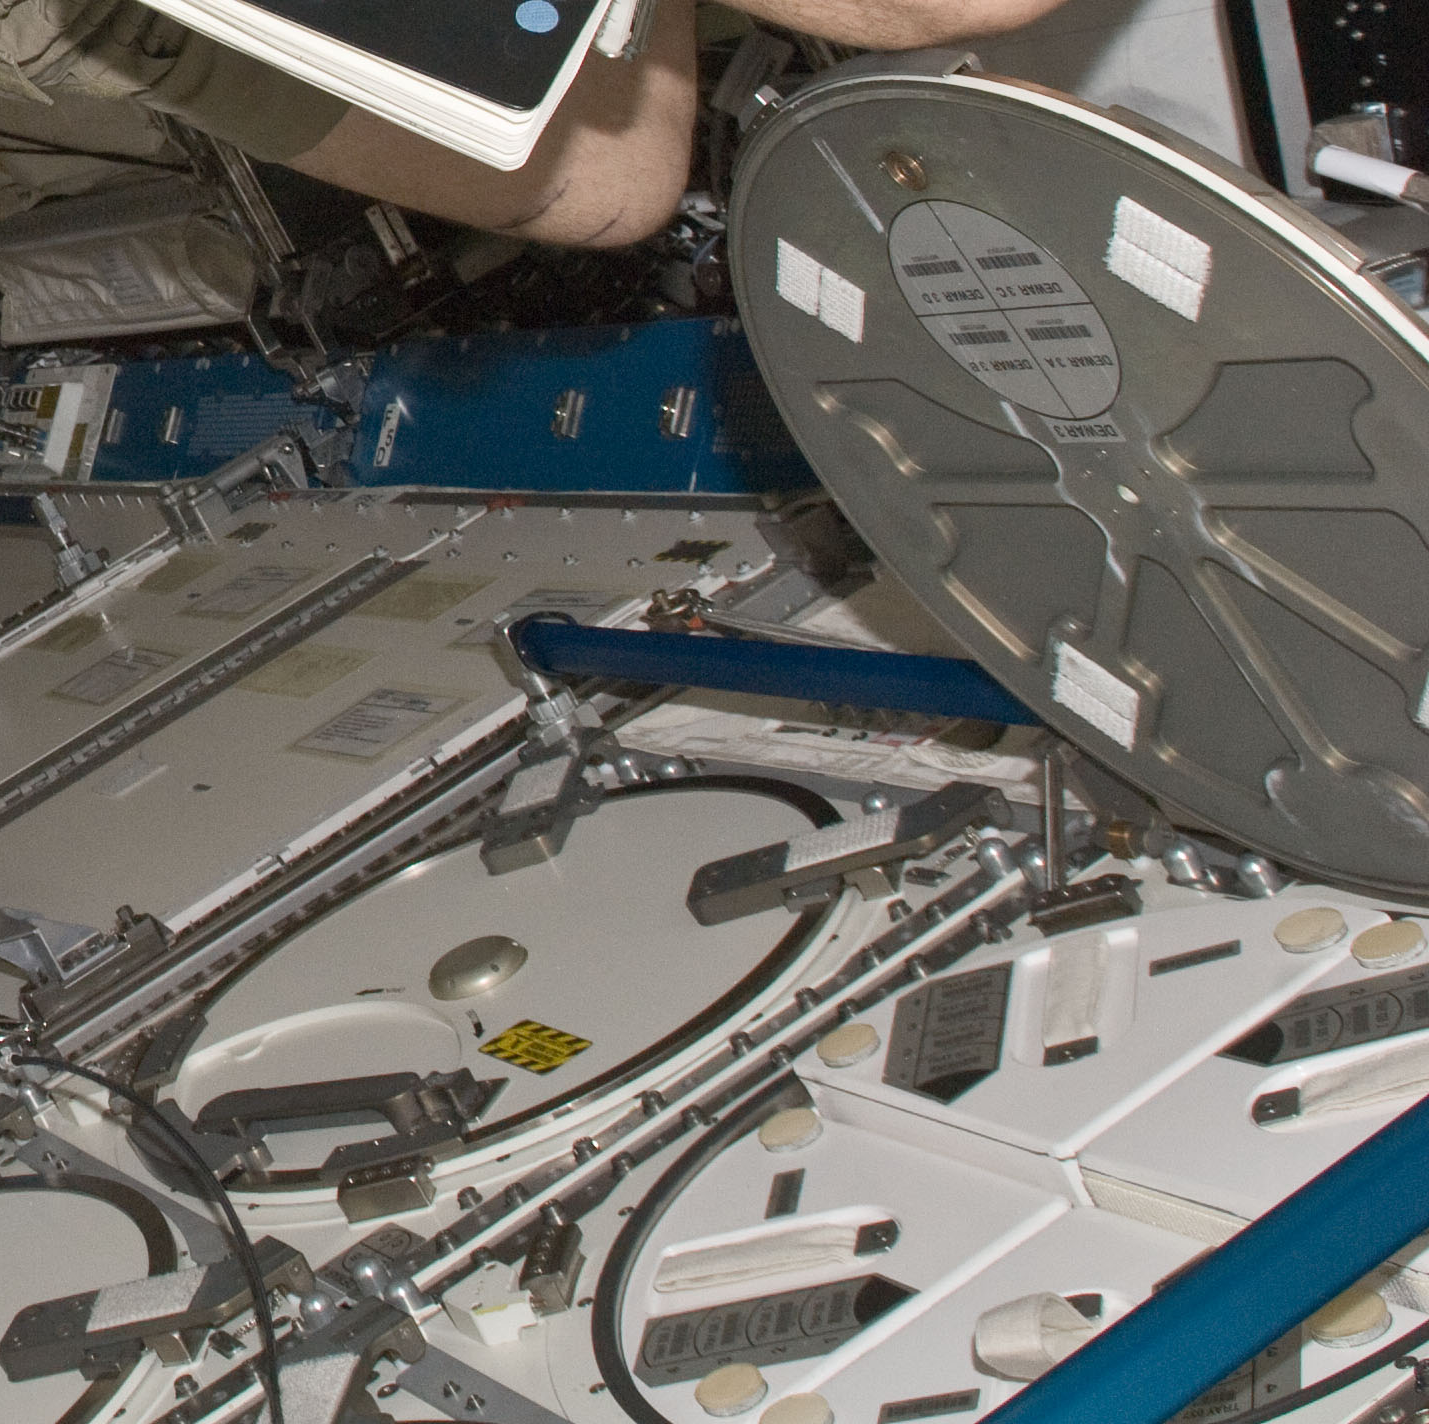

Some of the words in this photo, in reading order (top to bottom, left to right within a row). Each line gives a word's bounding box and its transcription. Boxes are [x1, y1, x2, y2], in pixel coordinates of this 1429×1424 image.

[942, 288, 984, 302] DEWAR
[1018, 281, 1062, 296] DEWAR
[989, 358, 1033, 372] DEWAR
[1067, 353, 1113, 368] DEWAR
[1053, 424, 1064, 437] 3
[1063, 420, 1118, 441] DEWAR
